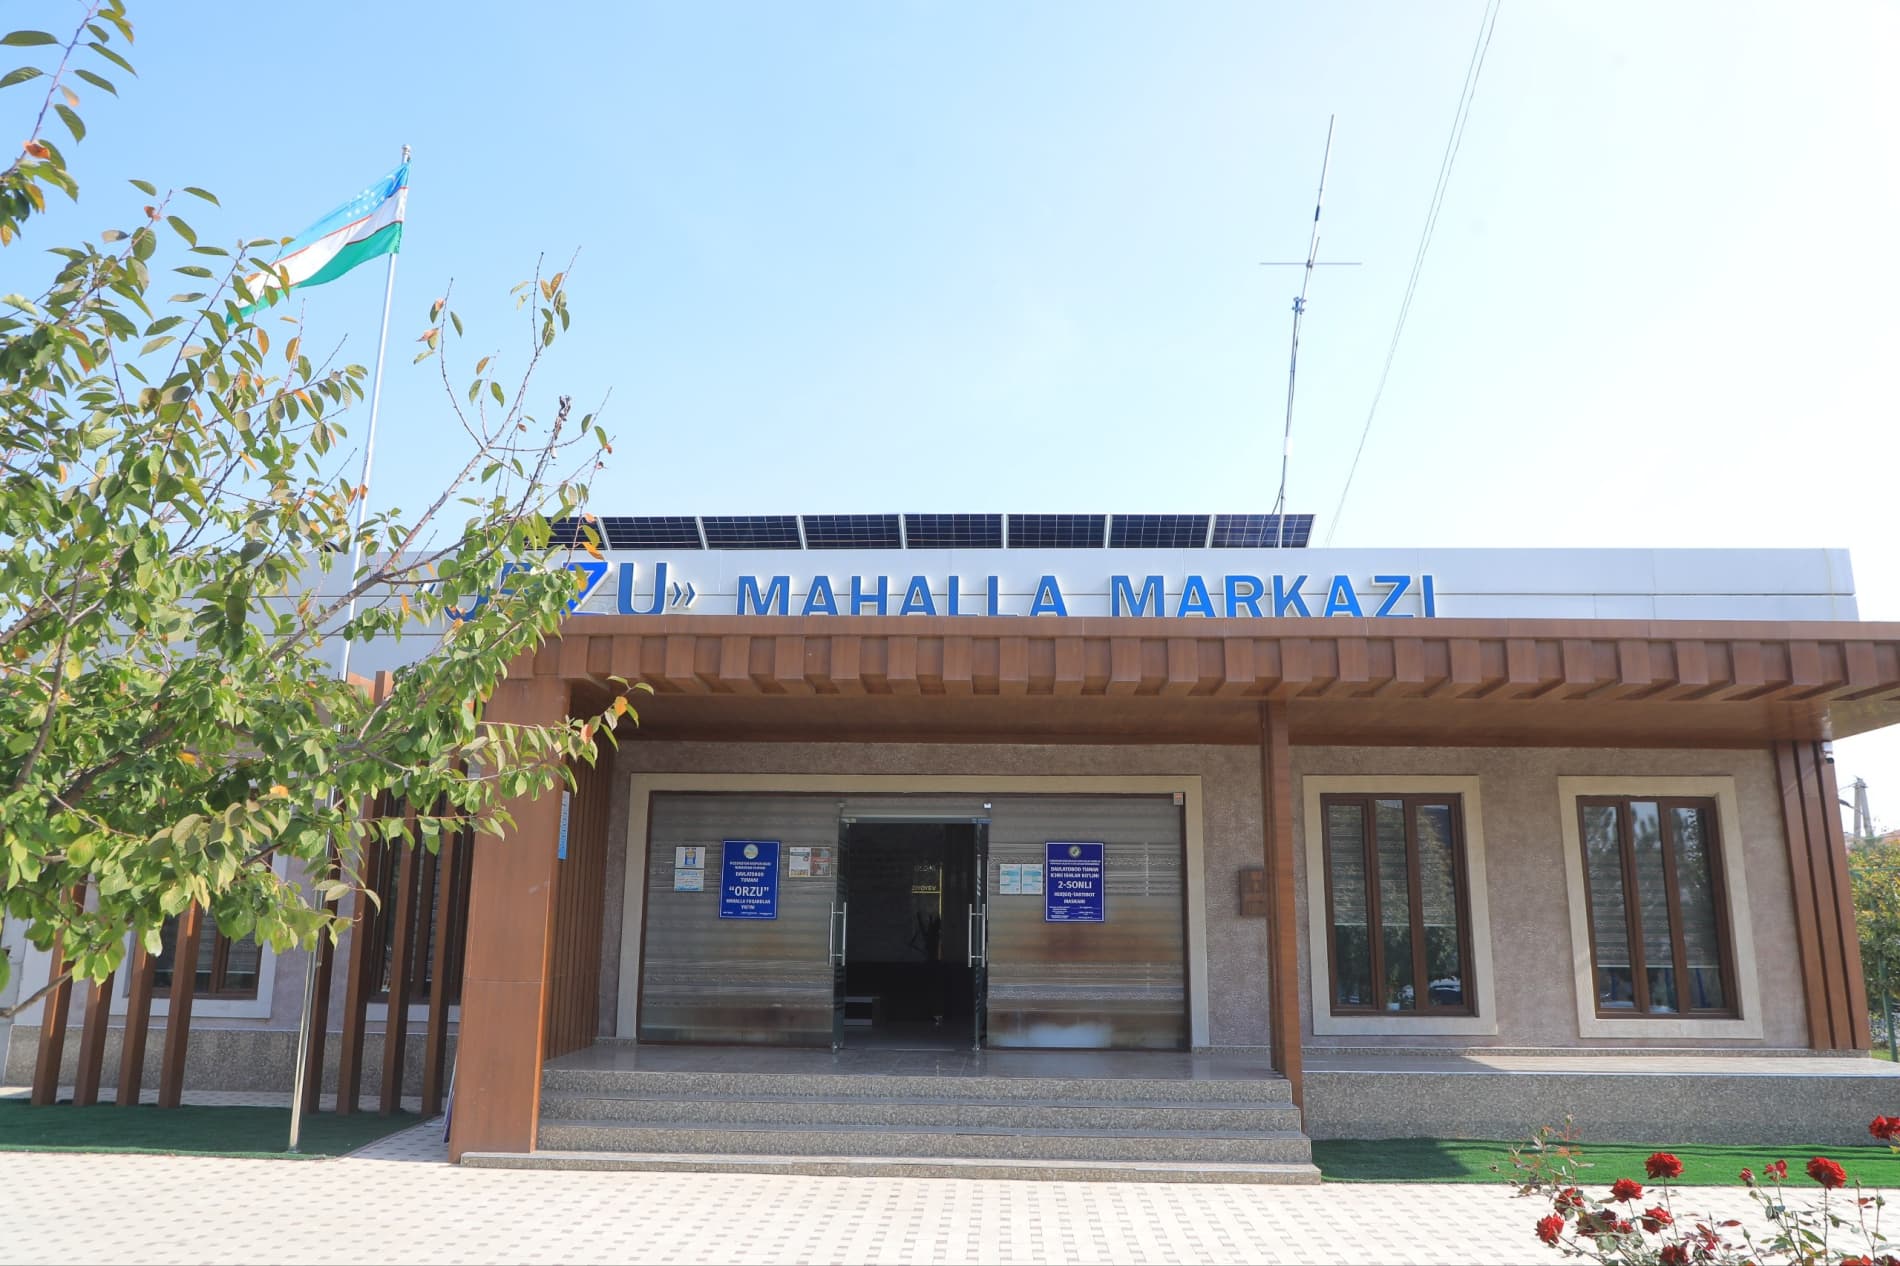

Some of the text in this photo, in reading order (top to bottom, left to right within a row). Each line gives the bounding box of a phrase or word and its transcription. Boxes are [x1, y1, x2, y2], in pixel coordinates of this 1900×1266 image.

[736, 575, 1069, 616] MAHALLA
[1110, 575, 1437, 617] MARKAZI
[1057, 880, 1092, 889] 2-SONLI
